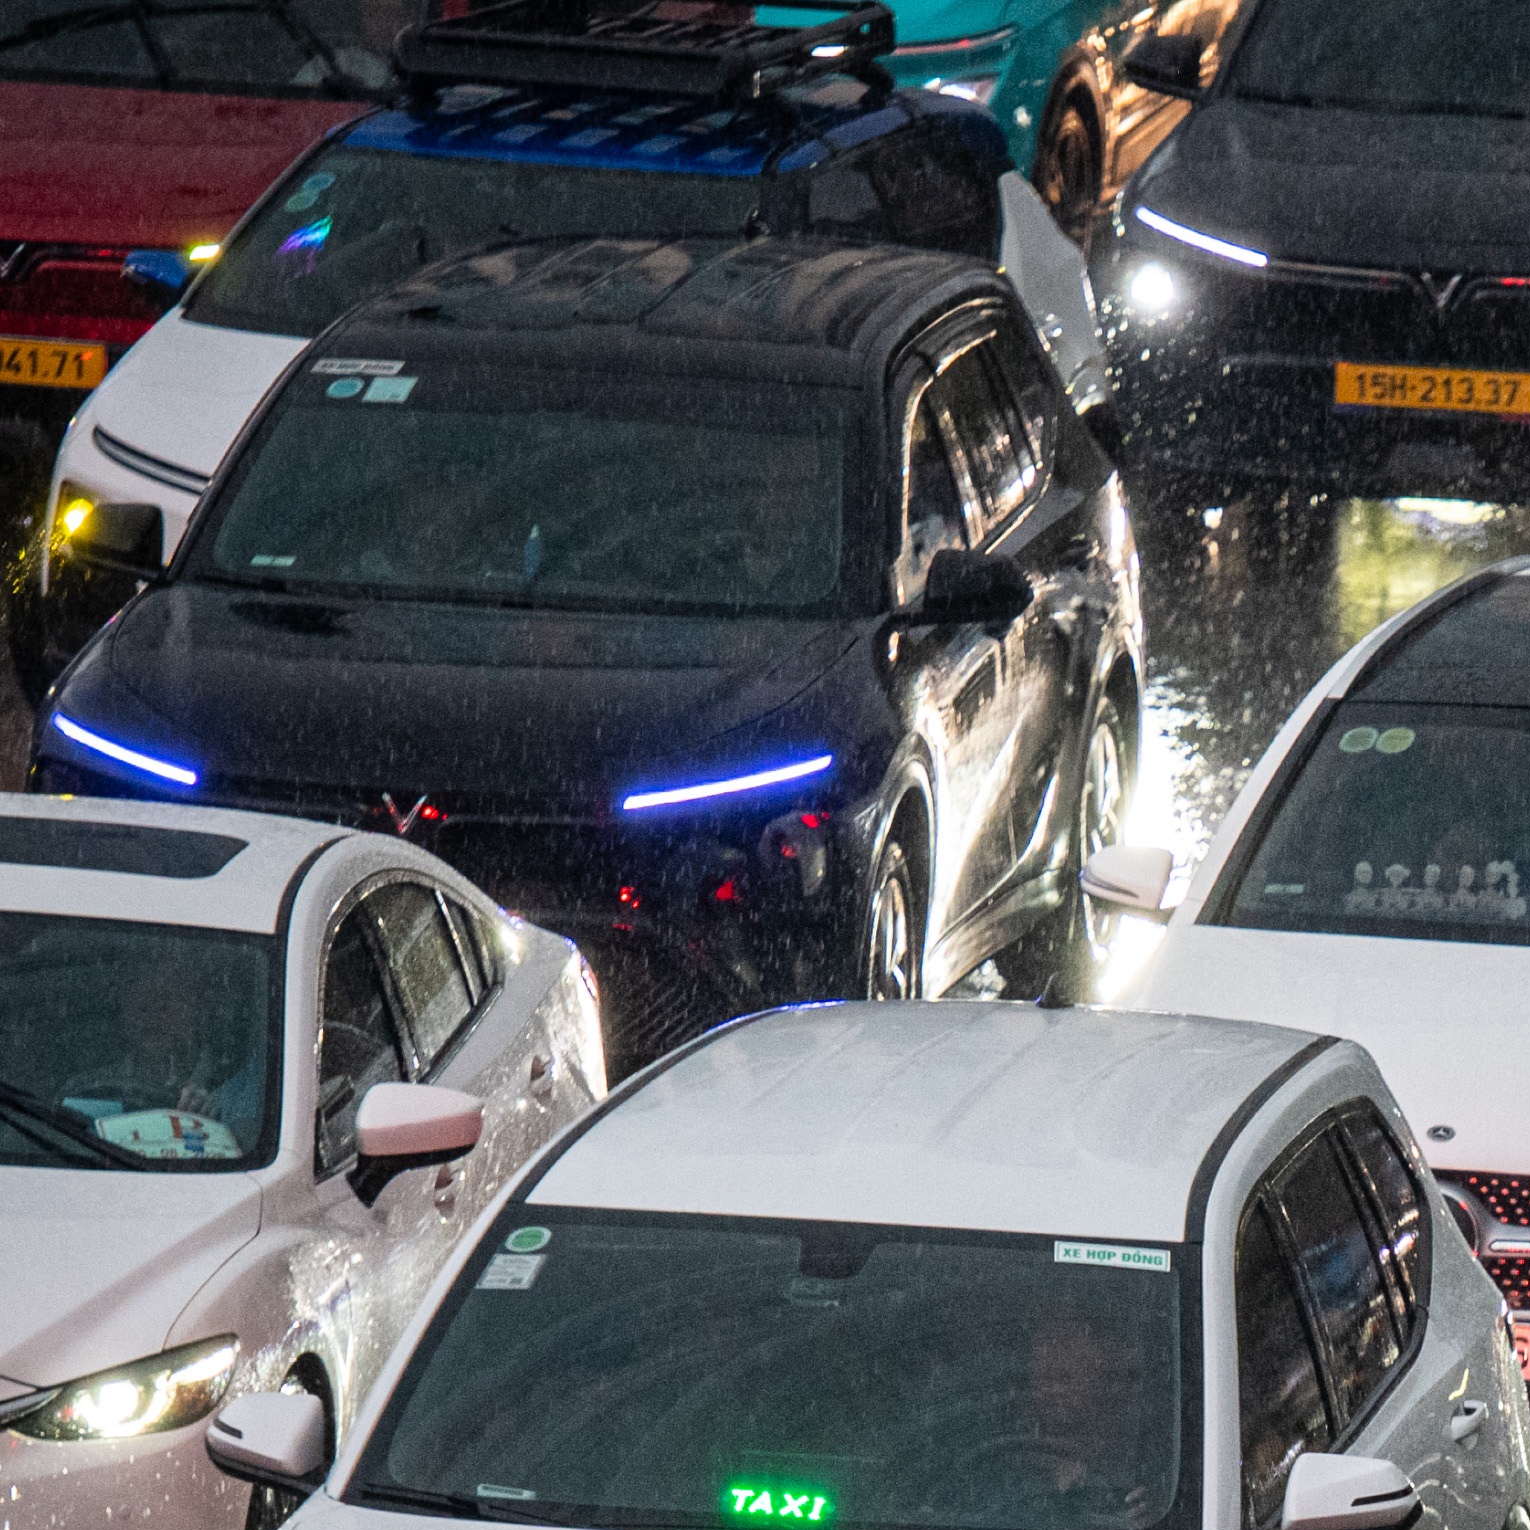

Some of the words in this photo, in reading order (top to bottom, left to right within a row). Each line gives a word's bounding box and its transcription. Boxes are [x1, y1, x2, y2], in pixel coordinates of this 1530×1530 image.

[0, 347, 86, 379] 41.71
[1063, 1247, 1081, 1258] XE
[1086, 1248, 1117, 1262] HỢP
[731, 1488, 826, 1520] TAXI
